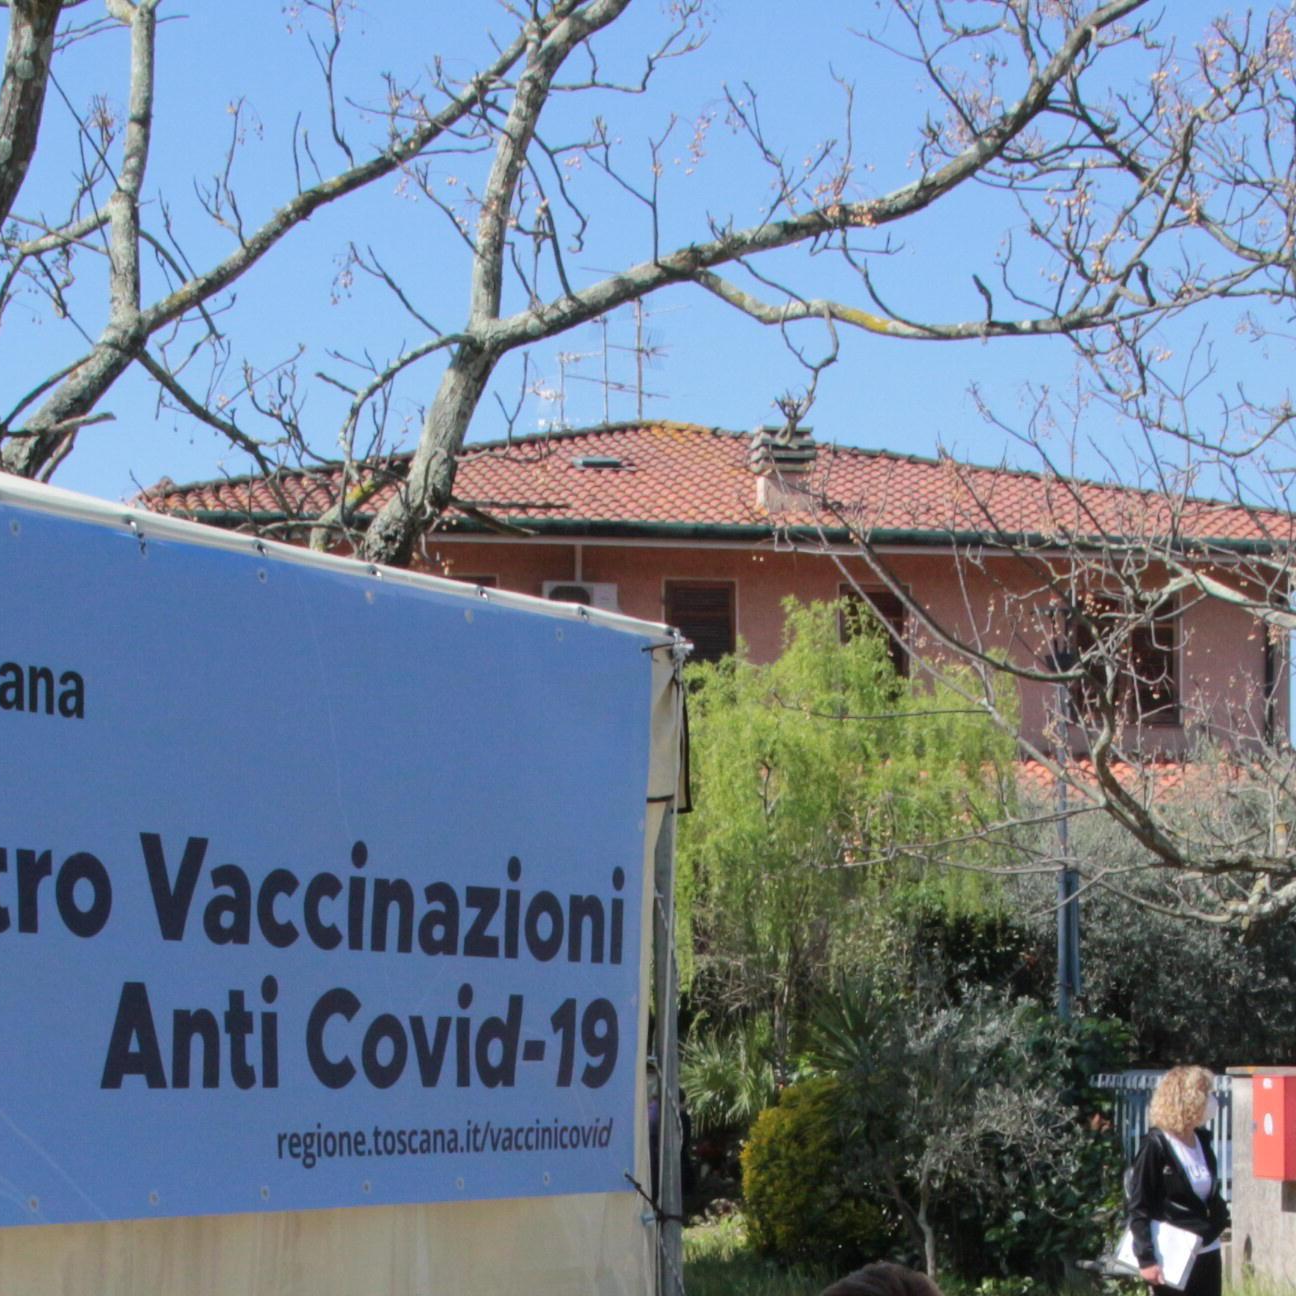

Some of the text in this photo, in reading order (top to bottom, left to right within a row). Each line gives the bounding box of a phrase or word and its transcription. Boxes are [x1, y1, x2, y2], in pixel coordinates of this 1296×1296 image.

[139, 831, 625, 965] Vaccinazioni
[100, 974, 619, 1090] Anti Covid-19
[277, 1117, 613, 1169] regione.toscana.it/vaccinicovid
